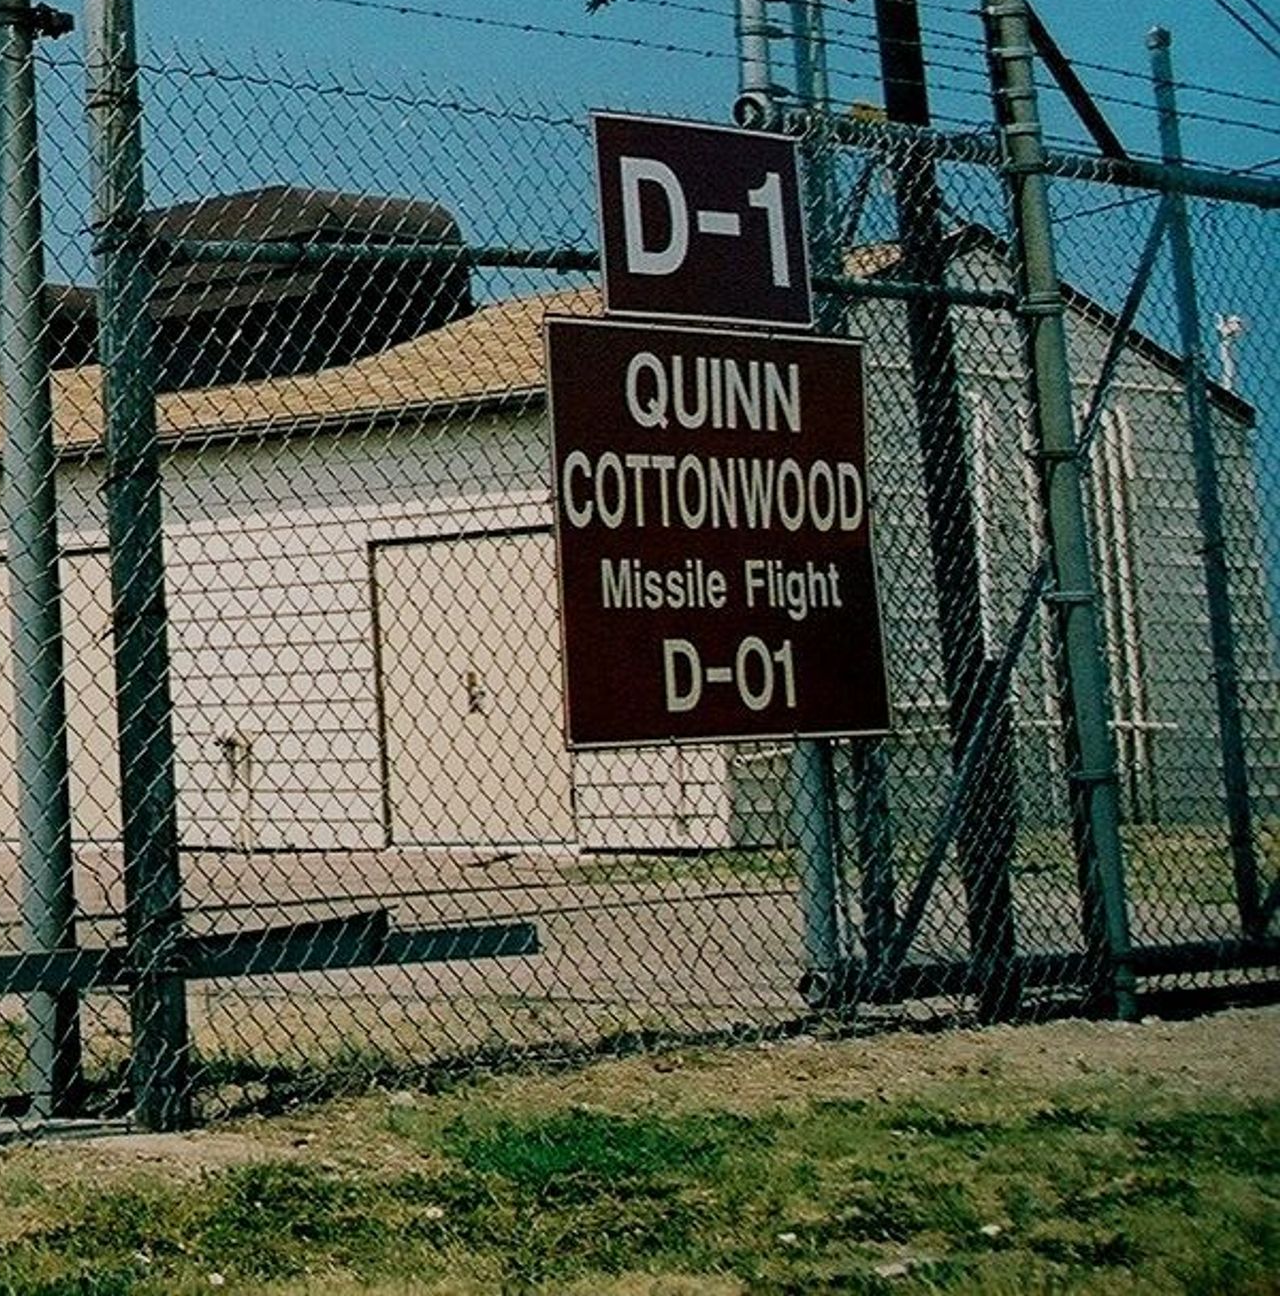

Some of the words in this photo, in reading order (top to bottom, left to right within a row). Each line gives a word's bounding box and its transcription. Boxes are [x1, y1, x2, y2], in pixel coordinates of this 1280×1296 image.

[619, 157, 790, 287] D-1
[627, 353, 801, 431] QUINN
[563, 451, 864, 530] COTTONWOOD
[602, 560, 726, 608] Missile
[747, 561, 842, 619] Flight
